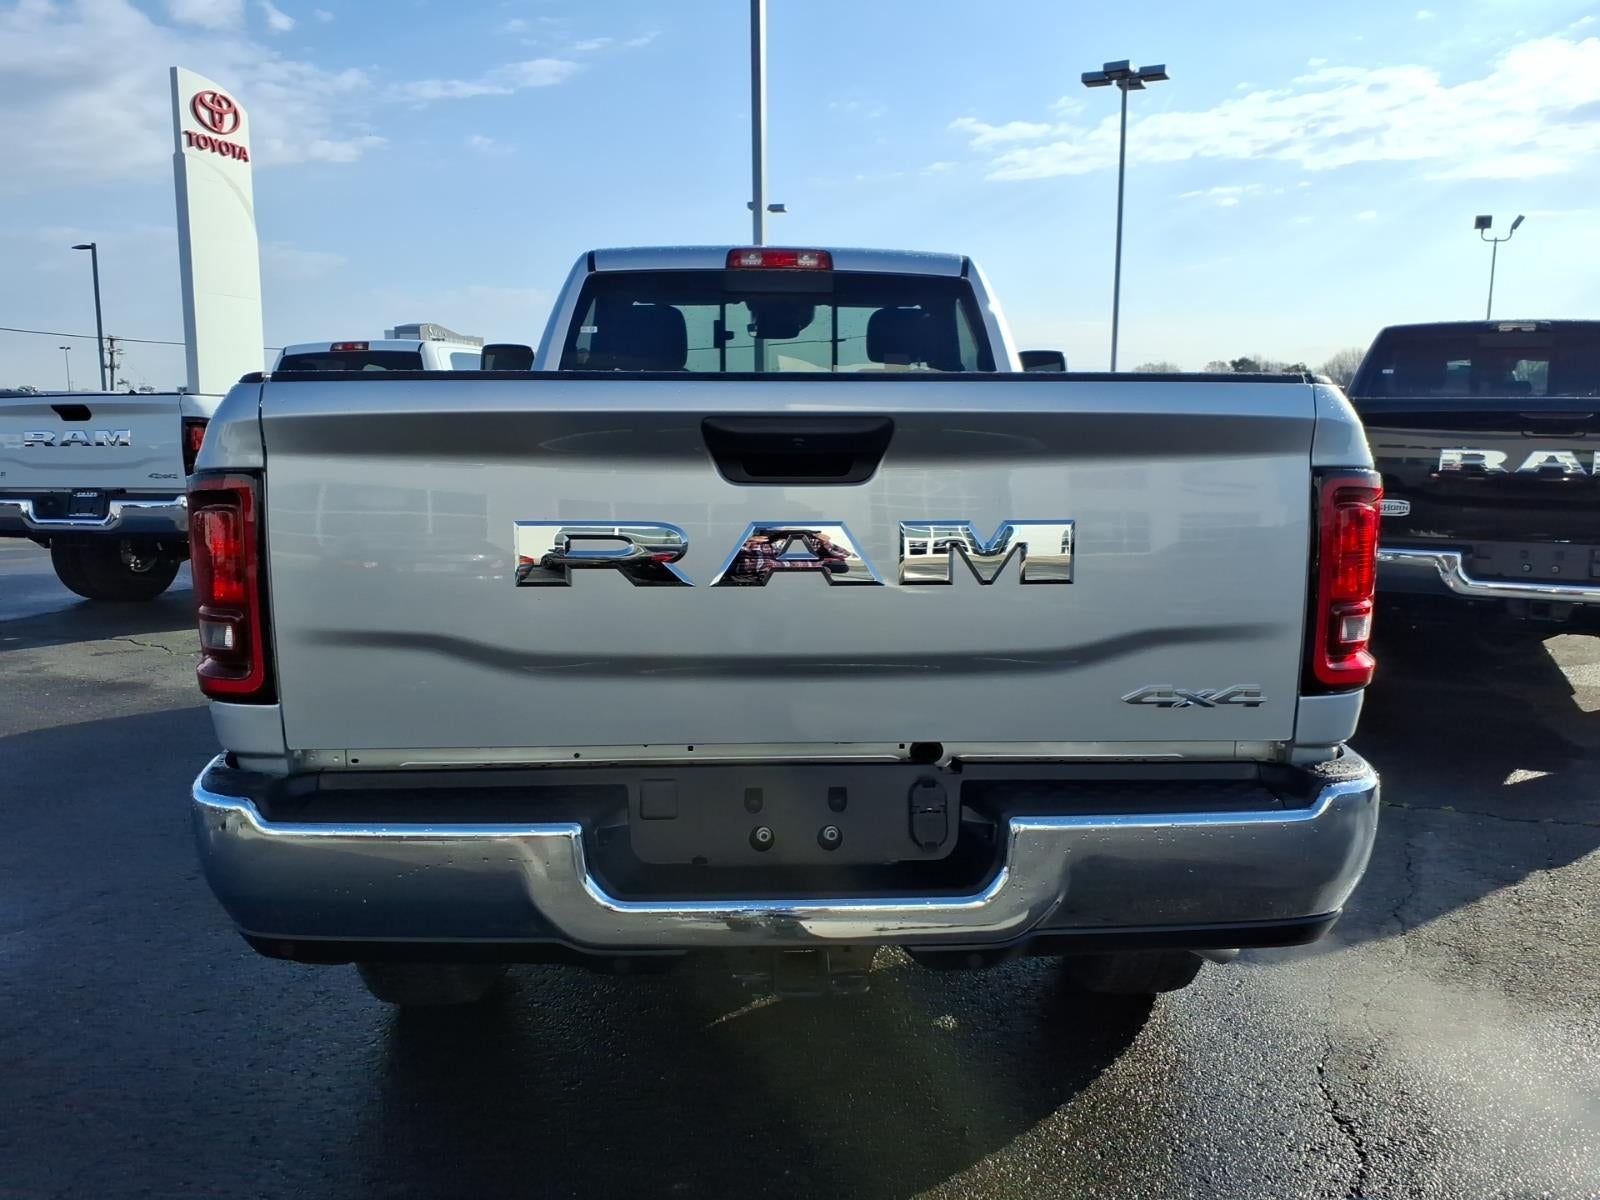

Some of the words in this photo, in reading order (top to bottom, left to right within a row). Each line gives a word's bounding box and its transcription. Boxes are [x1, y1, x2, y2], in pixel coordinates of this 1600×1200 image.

[183, 130, 249, 162] TOYOTA
[24, 429, 131, 447] RAM
[1439, 449, 1600, 475] RA
[513, 520, 1075, 587] RAM
